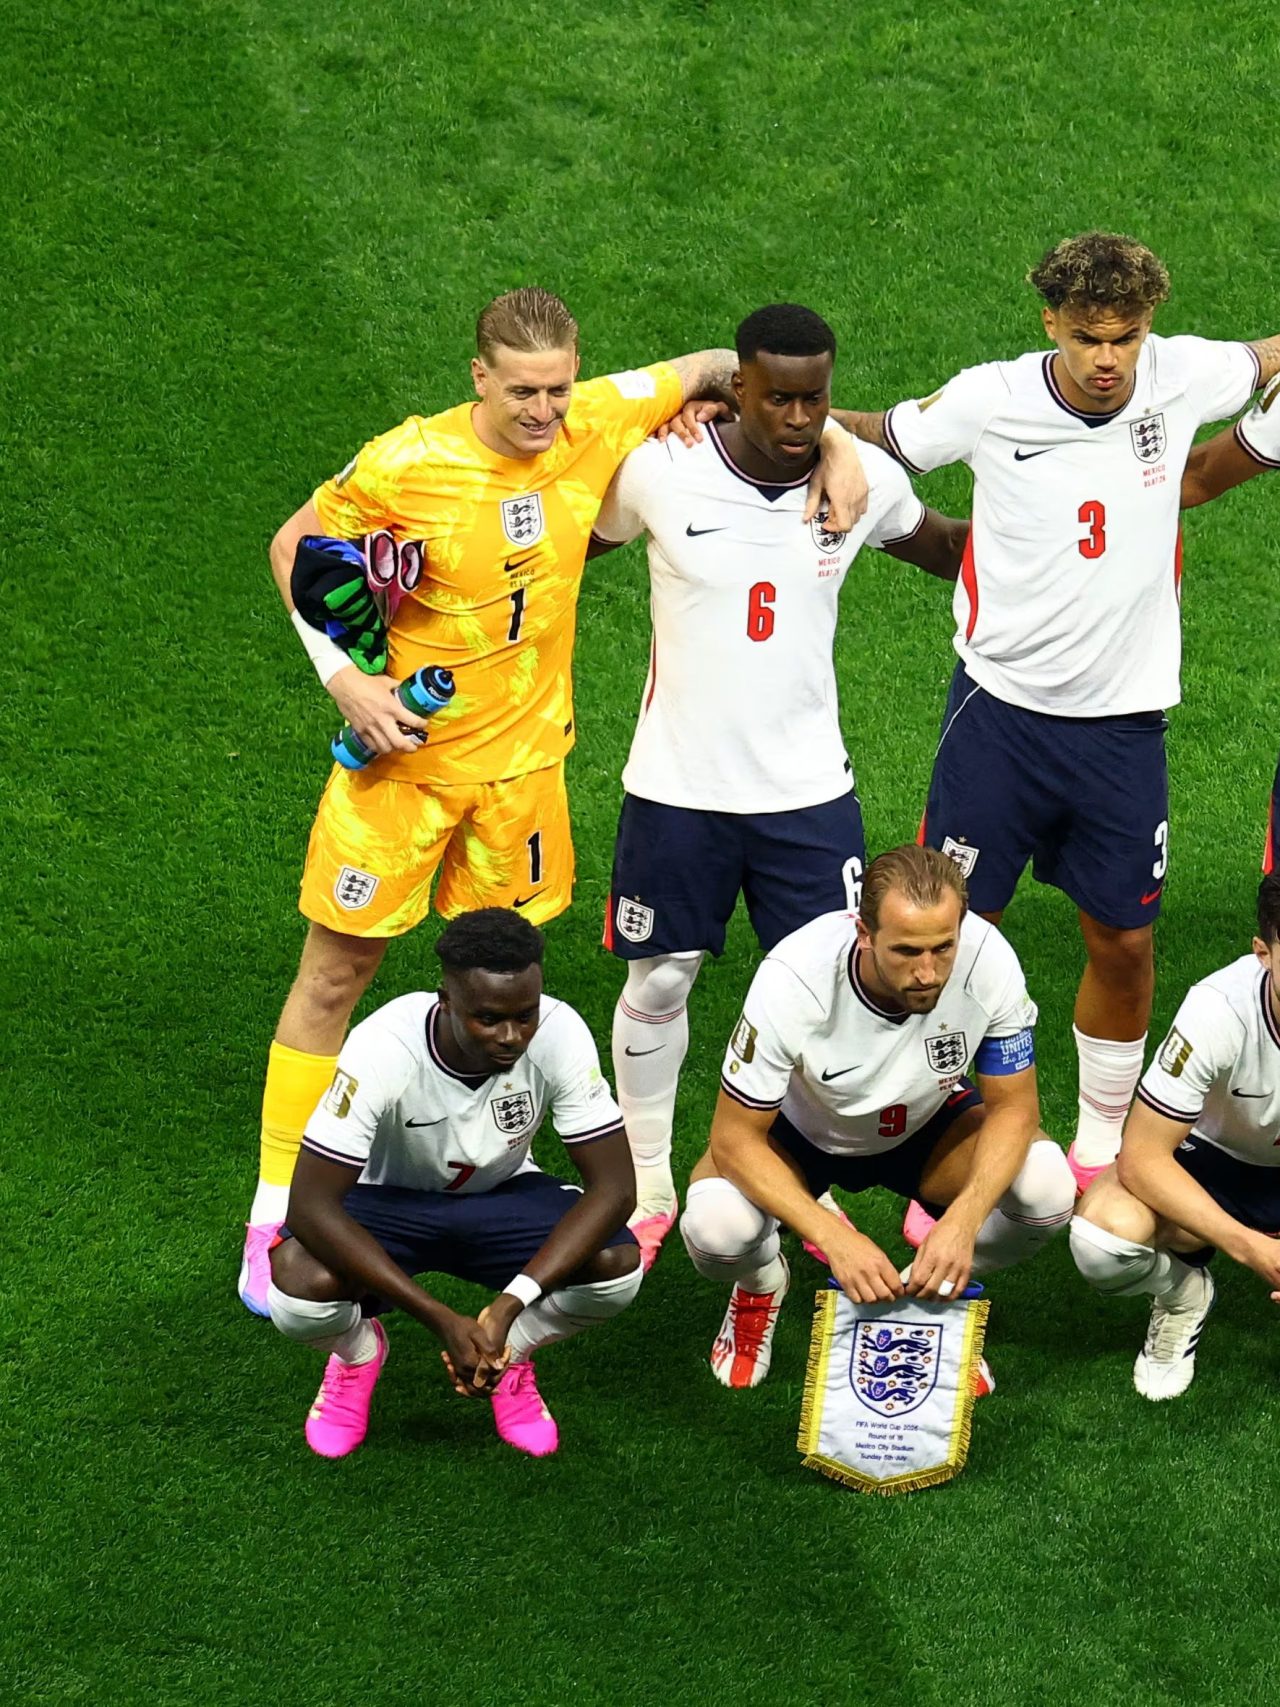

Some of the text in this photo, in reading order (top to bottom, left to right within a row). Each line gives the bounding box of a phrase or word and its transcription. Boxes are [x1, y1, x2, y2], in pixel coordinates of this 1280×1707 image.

[1143, 464, 1167, 477] MEXICO
[1078, 500, 1106, 560] 3
[818, 556, 842, 567] MEXICO
[510, 568, 536, 580] MEXICO
[507, 586, 526, 643] 1
[747, 581, 776, 642] 6
[526, 829, 543, 885] 1
[1152, 820, 1169, 880] 3
[842, 856, 864, 912] 6
[1000, 1033, 1033, 1056] UNITES
[938, 1073, 962, 1085] MEXIC
[878, 1103, 908, 1138] 9
[443, 1160, 476, 1192] 7
[855, 1420, 869, 1429] FIFA
[870, 1422, 888, 1430] World
[889, 1423, 901, 1432] Cup
[868, 1432, 883, 1440] Round
[855, 1442, 915, 1452] Mexico City Stadium
[860, 1453, 882, 1461] Sunday
